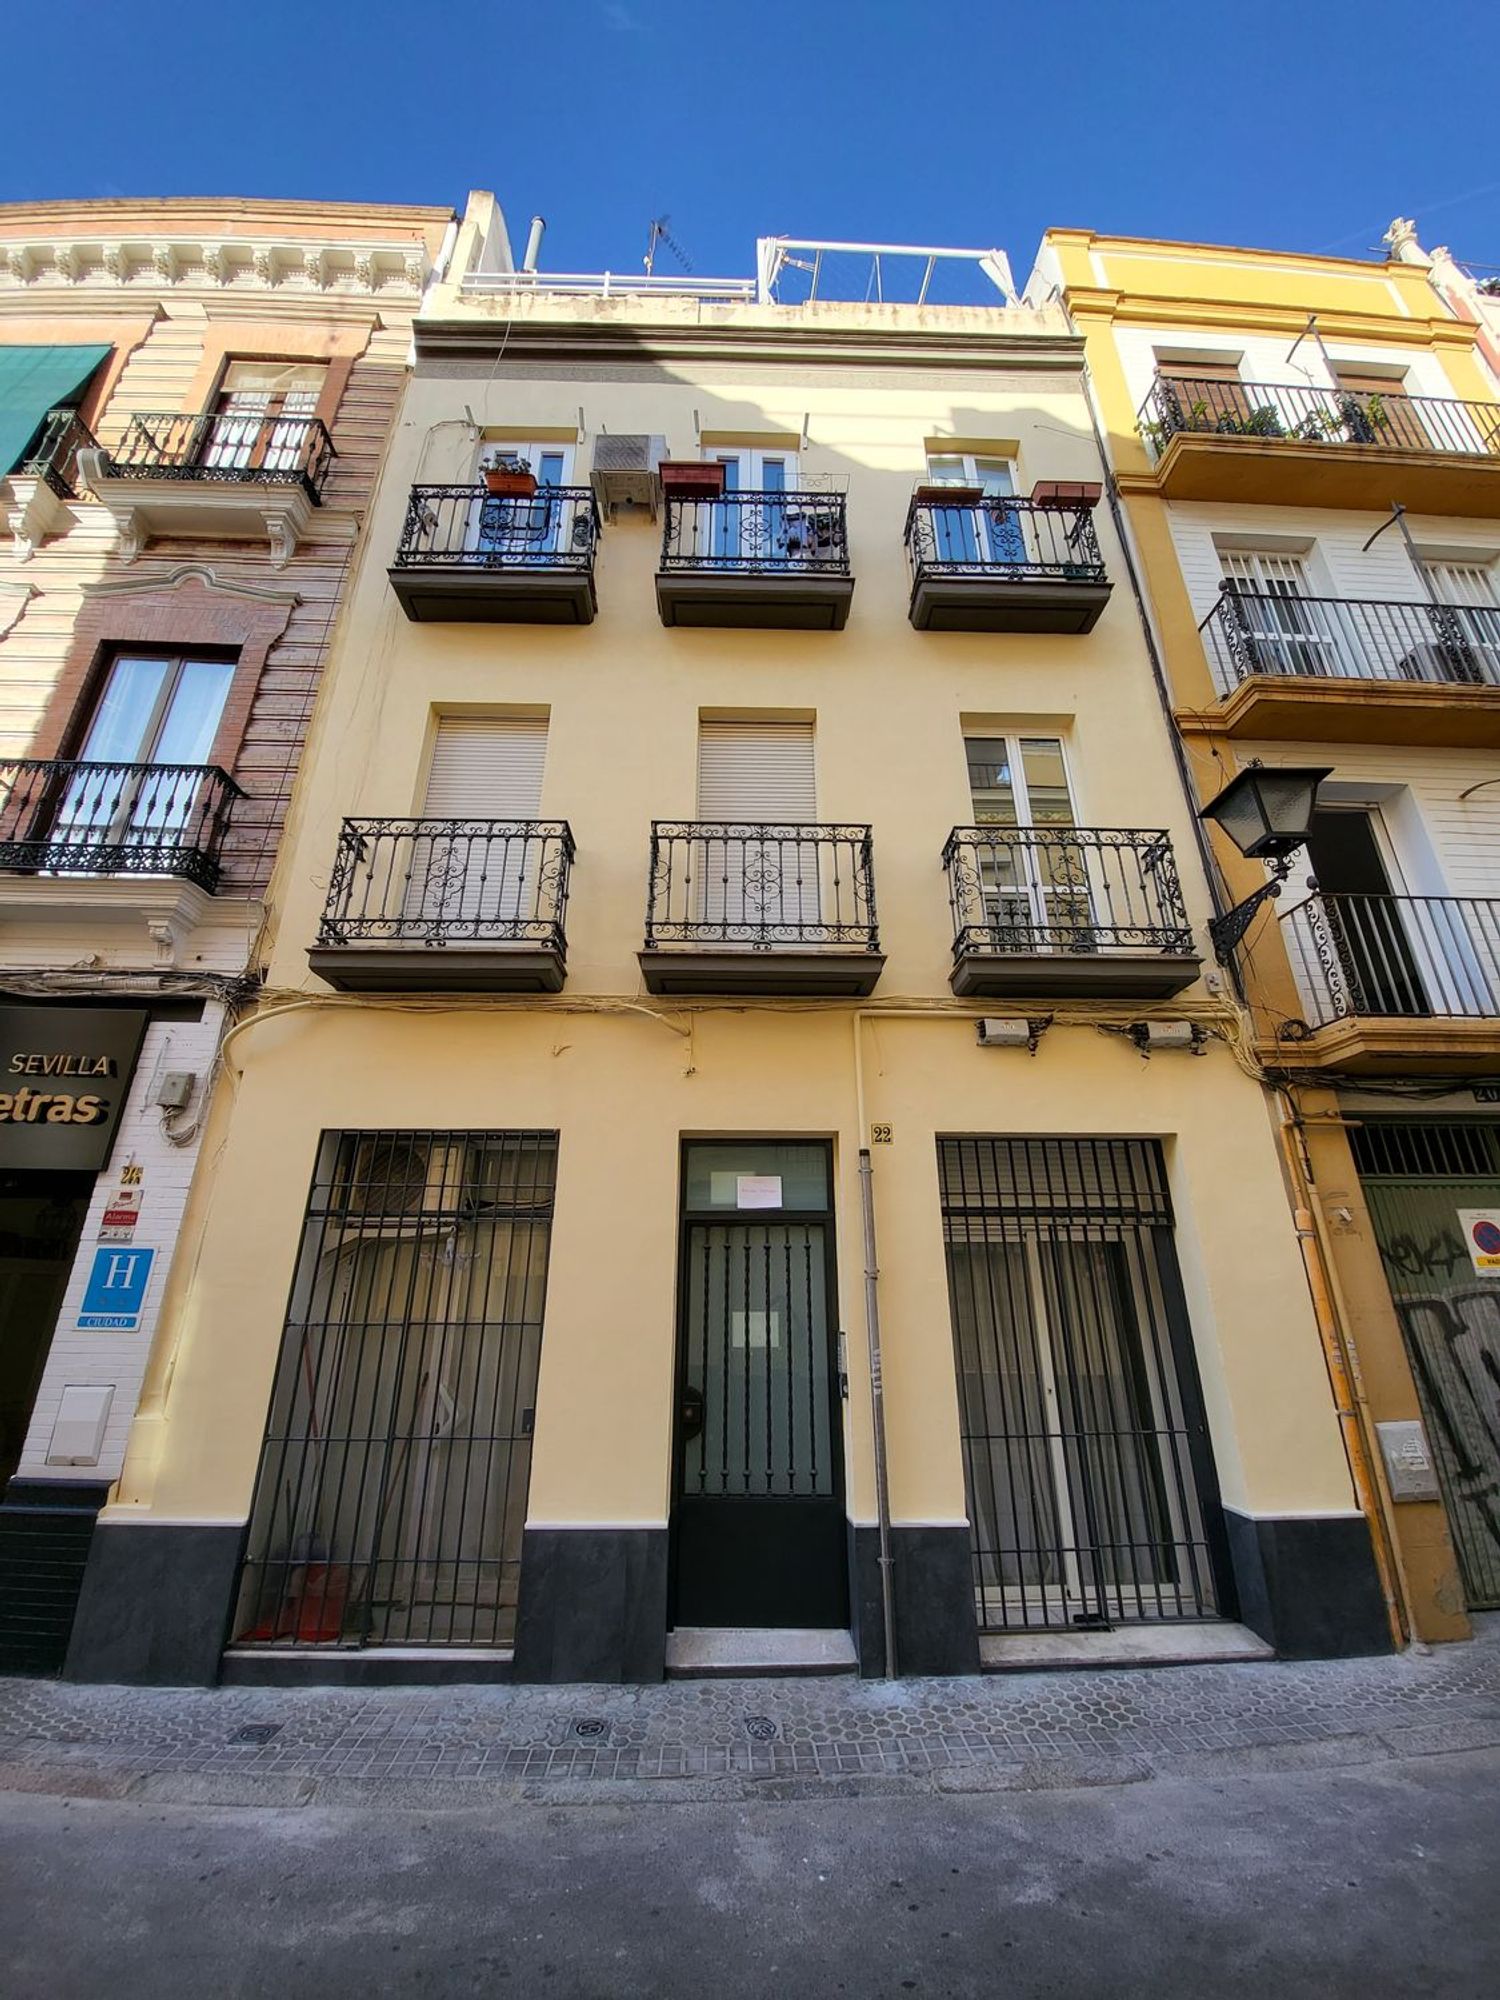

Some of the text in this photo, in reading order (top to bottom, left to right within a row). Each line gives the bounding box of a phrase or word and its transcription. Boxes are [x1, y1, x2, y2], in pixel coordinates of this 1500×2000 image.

[8, 1053, 109, 1075] SEVILLA
[0, 1086, 101, 1123] etras
[873, 1126, 891, 1143] 22
[102, 1254, 141, 1289] H
[86, 1317, 128, 1327] CIUDAD
